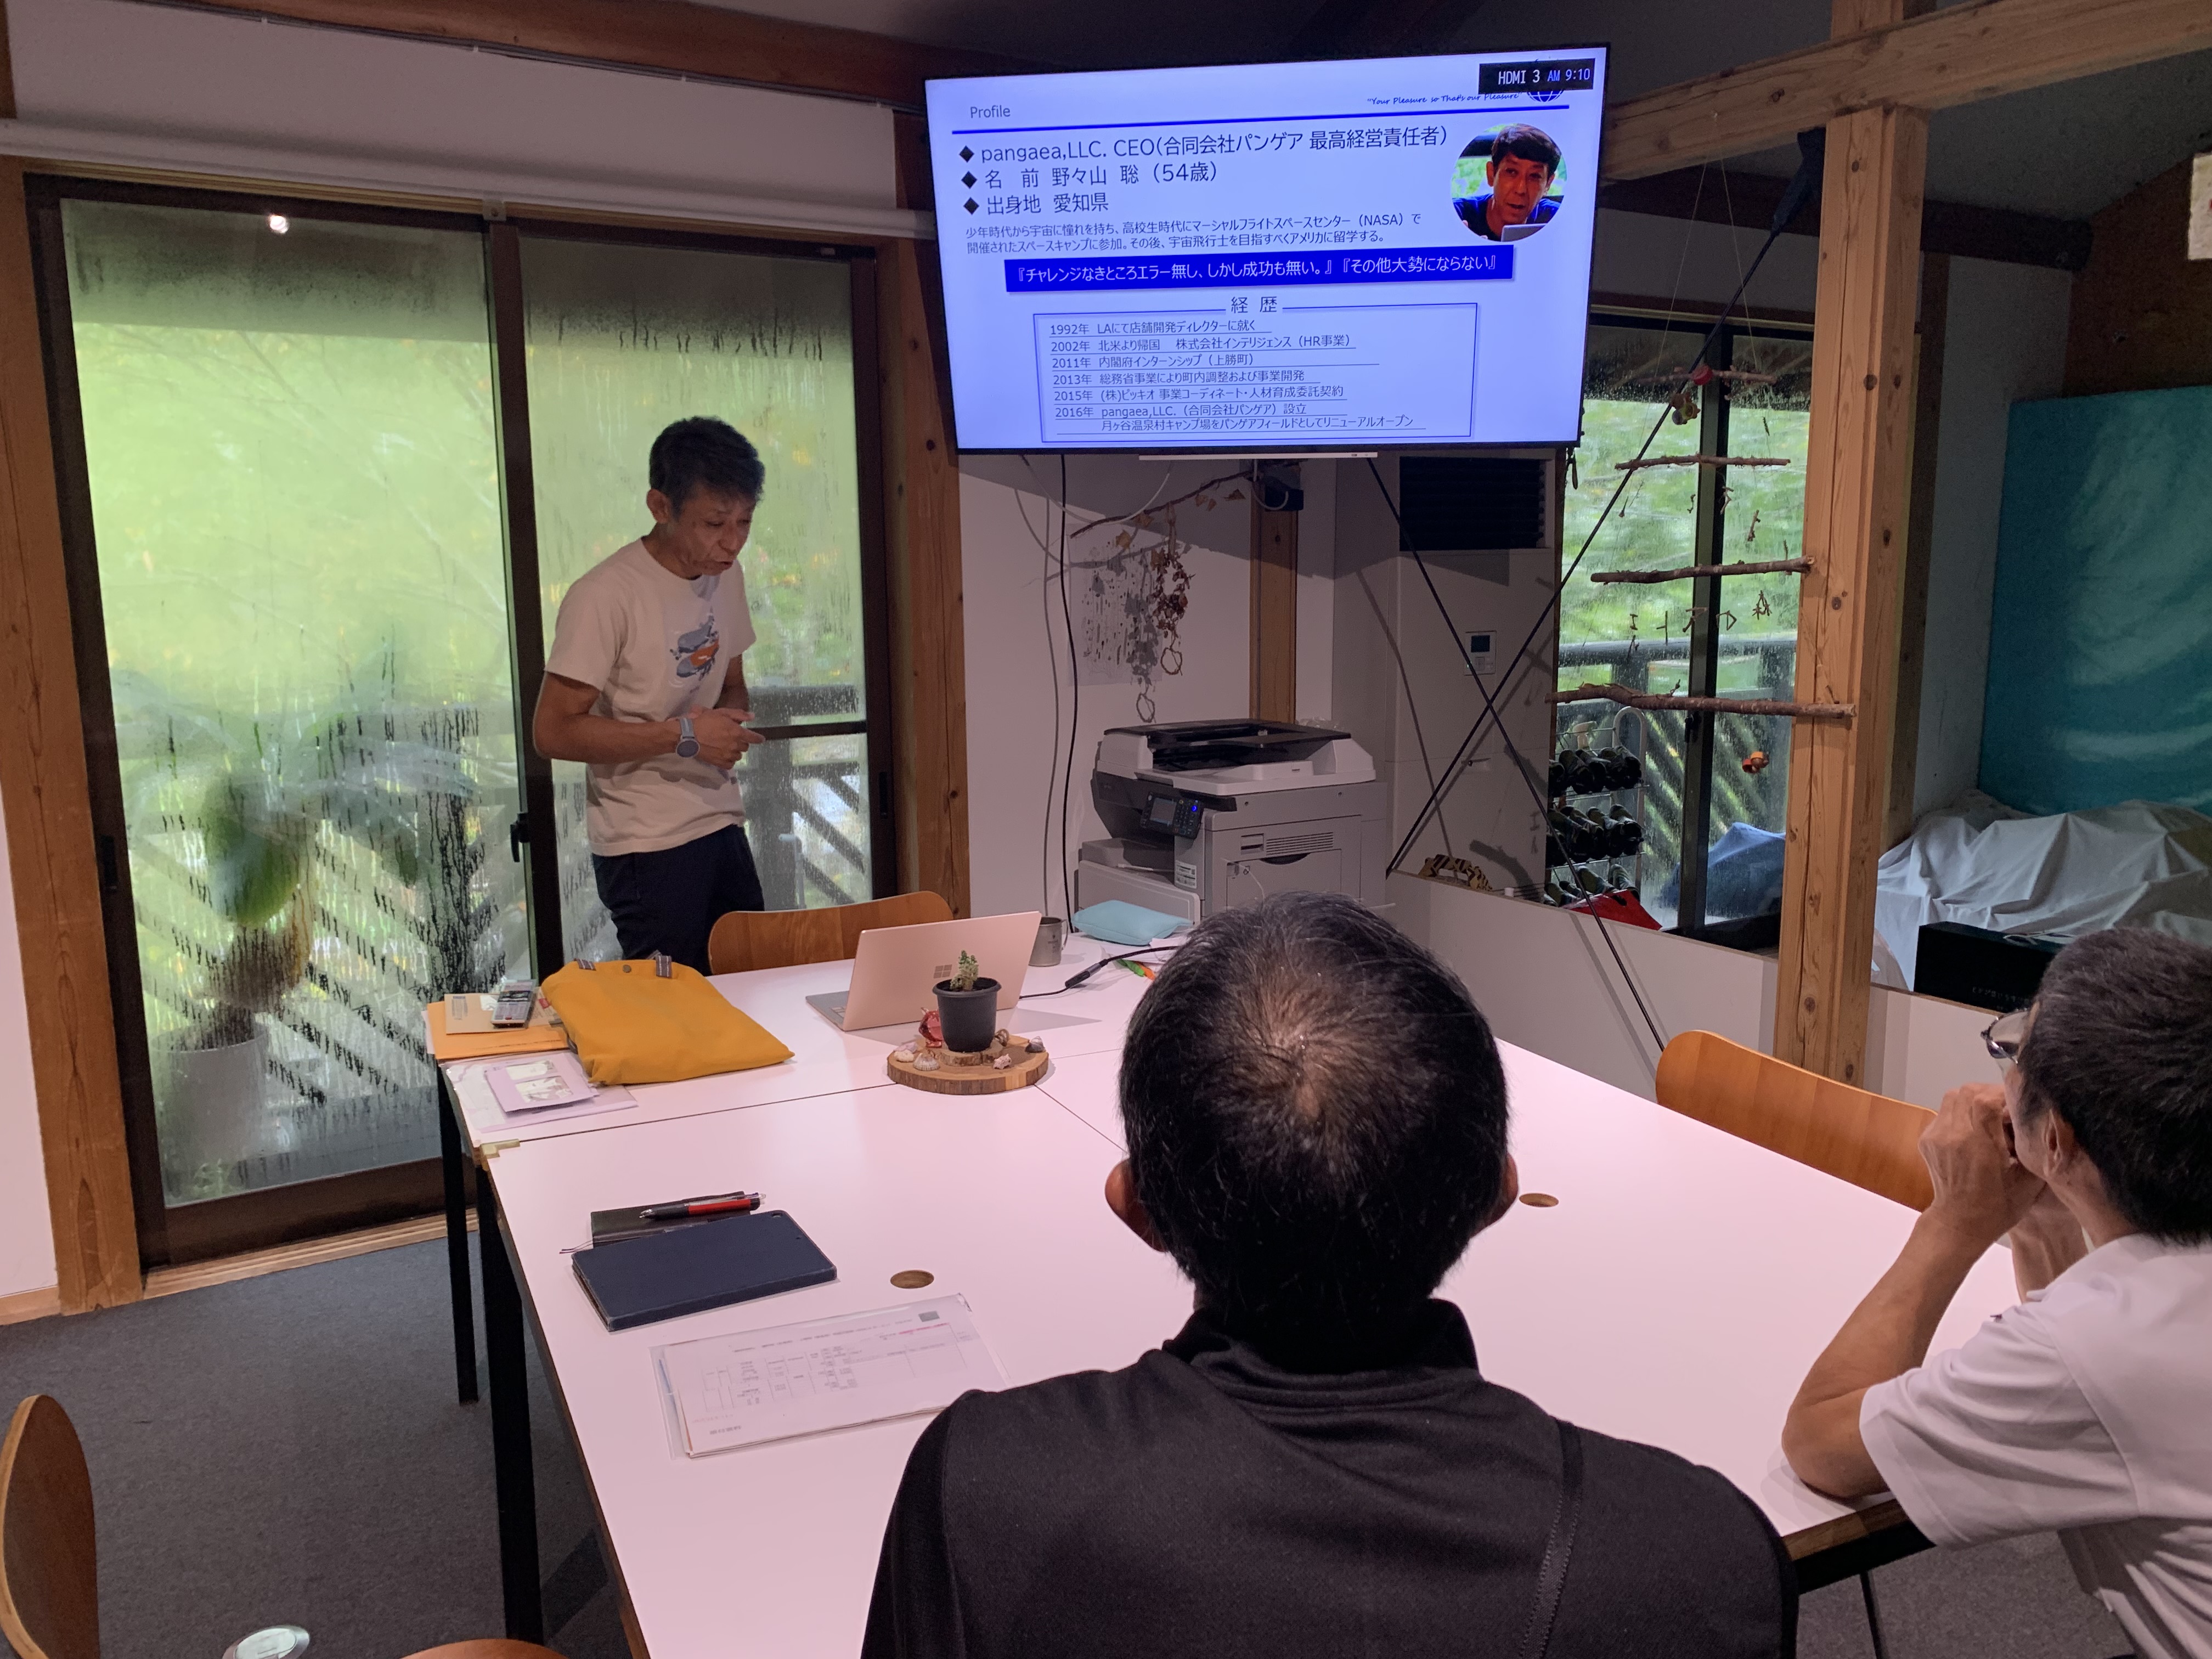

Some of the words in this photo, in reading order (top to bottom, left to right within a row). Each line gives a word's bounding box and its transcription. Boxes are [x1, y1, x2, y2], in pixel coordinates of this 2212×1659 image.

[1498, 70, 1526, 84] HDMI
[1532, 70, 1540, 83] 3
[1547, 70, 1560, 82] AM
[1565, 68, 1590, 81] 9:10
[1393, 96, 1427, 104] Pleasure
[970, 105, 1011, 119] Profile
[981, 140, 1107, 163] pangaea,LLC.
[1052, 165, 1107, 187] 野々山
[988, 194, 1041, 216] 出身地
[1053, 192, 1109, 213] 愛知県
[1050, 323, 1089, 335] 1992年
[1097, 319, 1255, 334] LAにて店舗開発ディレクターに就く
[1051, 341, 1091, 352] 2002年
[1098, 339, 1160, 351] 北米より帰国
[1052, 357, 1091, 368] 2011年
[1053, 374, 1092, 385] 2013年
[1099, 370, 1305, 385] 総務省事業により町内調整および事業開発
[1054, 390, 1093, 401] 2015年
[1055, 406, 1094, 417] 2016年
